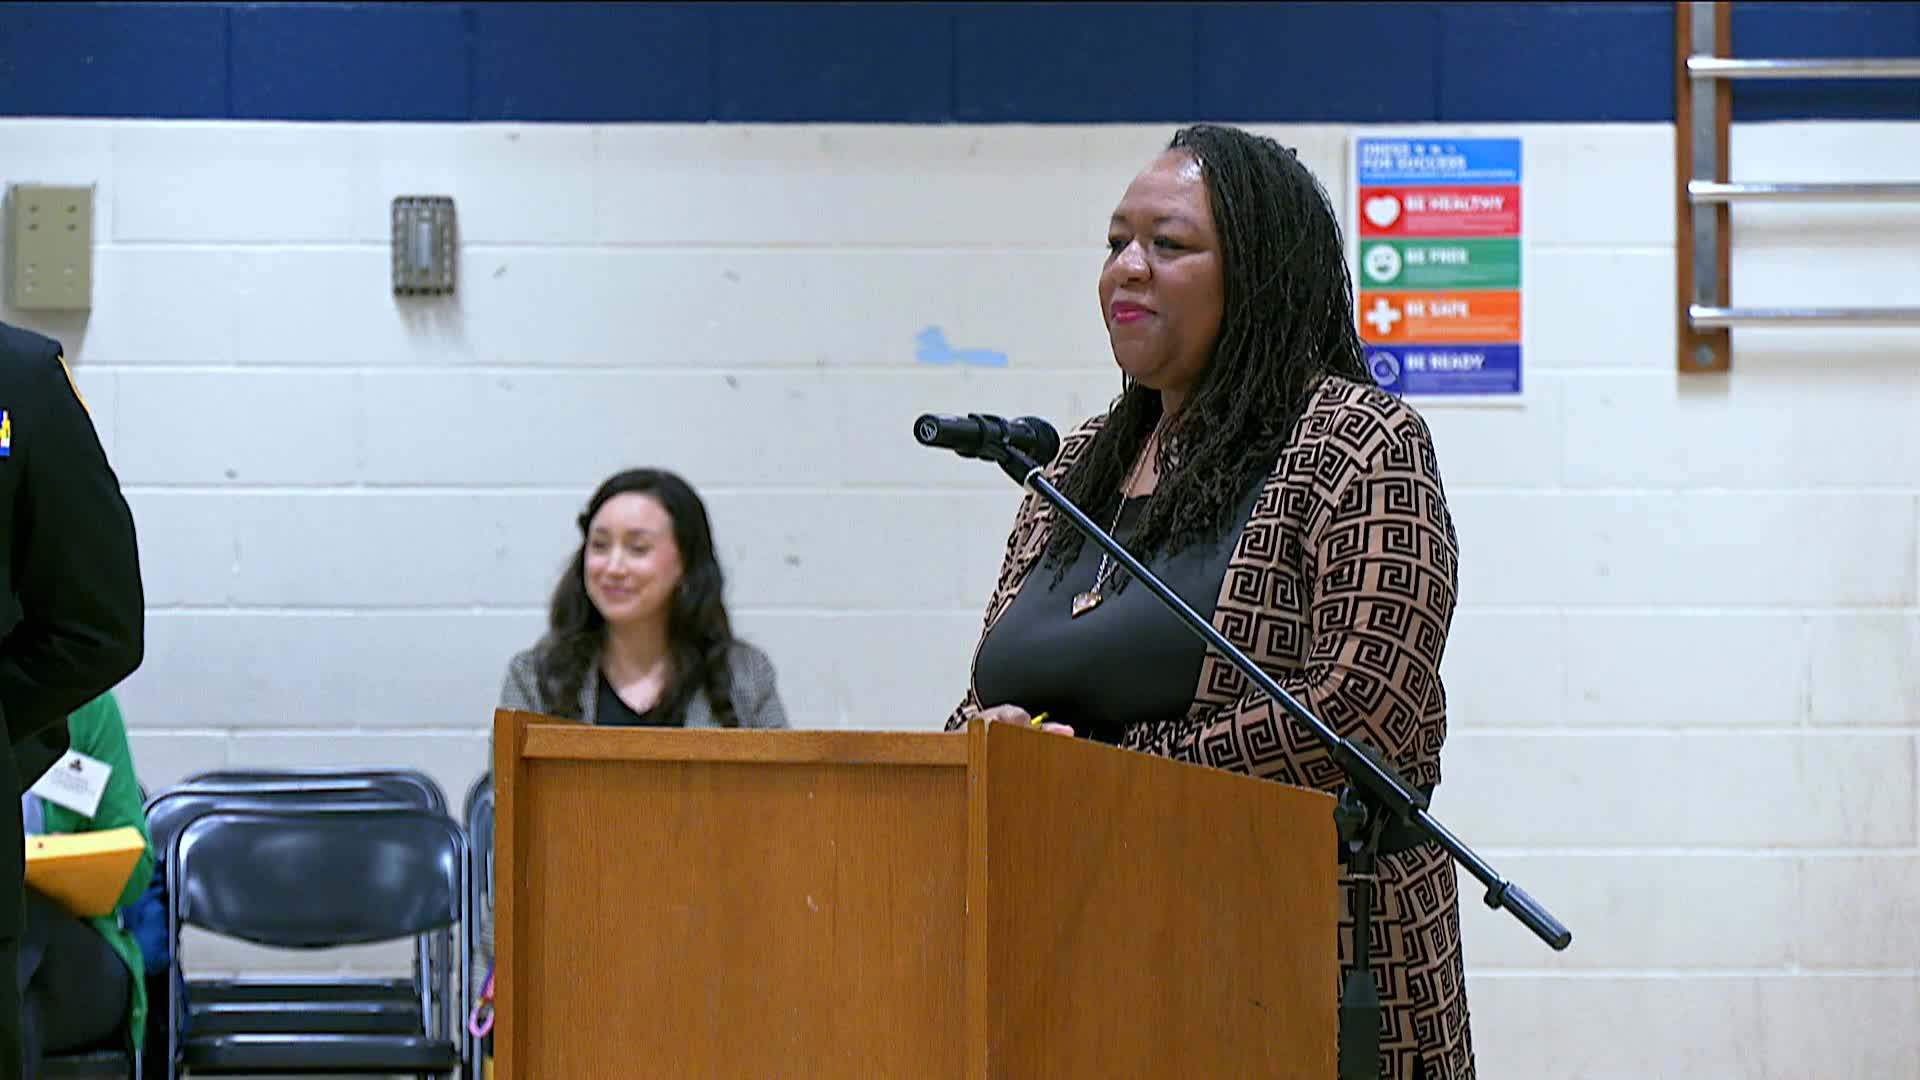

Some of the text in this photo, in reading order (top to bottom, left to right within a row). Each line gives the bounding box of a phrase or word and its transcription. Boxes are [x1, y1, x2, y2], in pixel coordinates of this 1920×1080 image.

[1405, 195, 1504, 212] BE HEALTHY
[1405, 248, 1425, 264] BE
[1405, 301, 1469, 319] BE SAFE
[1405, 353, 1485, 371] BE READY
